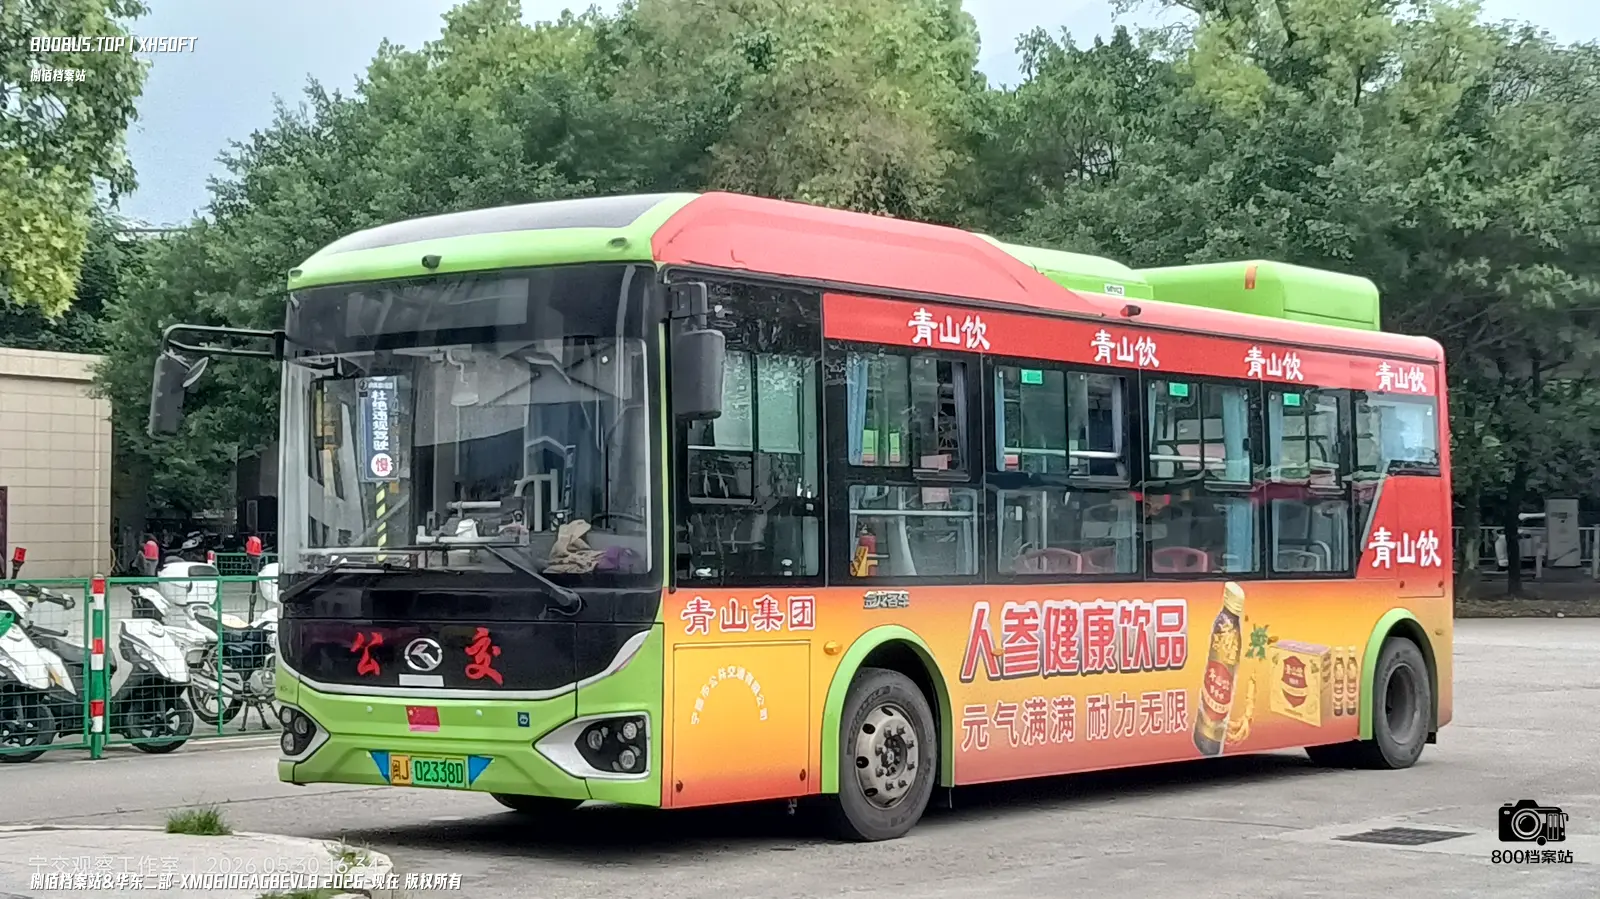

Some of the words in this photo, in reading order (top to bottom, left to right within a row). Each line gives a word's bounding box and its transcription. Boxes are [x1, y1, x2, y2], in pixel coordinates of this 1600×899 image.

[908, 307, 991, 351] 青山饮
[1091, 329, 1160, 369] 青山饮
[1244, 346, 1304, 382] 青山饮
[1375, 361, 1428, 394] 青山饮
[1369, 526, 1442, 569] 青山饮
[680, 594, 817, 635] 青山集团
[350, 631, 383, 676] 公
[464, 627, 504, 685] 交
[959, 597, 1189, 683] 人参健康饮品
[961, 694, 1077, 753] 元气满满
[1086, 688, 1190, 742] 耐力无限
